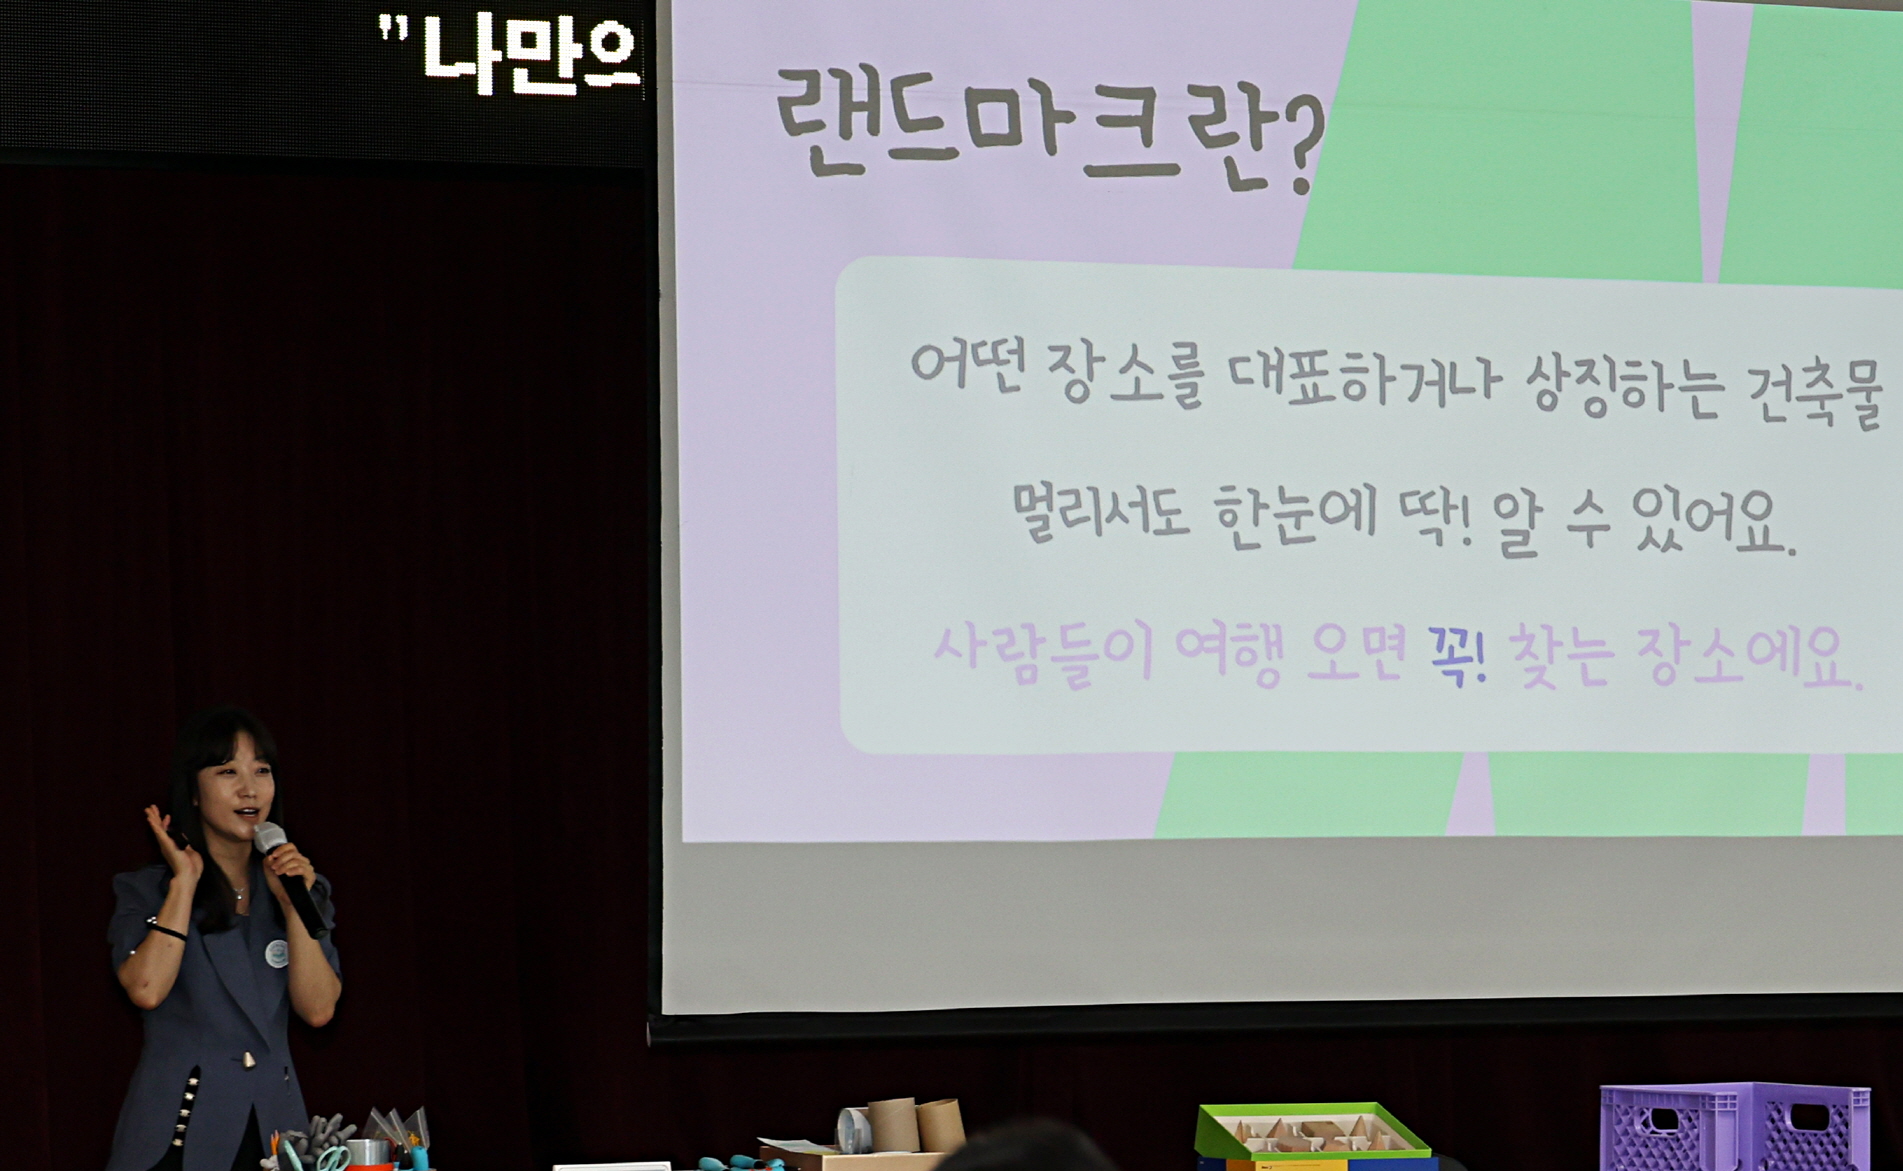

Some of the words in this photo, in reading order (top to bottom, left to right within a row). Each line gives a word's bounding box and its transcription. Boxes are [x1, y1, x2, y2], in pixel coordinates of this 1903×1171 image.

[777, 63, 1325, 196] 랜드마크란?
[910, 334, 1026, 396] 어떤
[1047, 337, 1206, 411] 장소를
[1227, 345, 1504, 409] 대표하거나
[1525, 350, 1726, 421] 상징하는
[1747, 354, 1884, 433] 건축물
[1013, 479, 1191, 545] 멀리서도
[1213, 482, 1377, 552] 한눈에
[1399, 484, 1472, 548] 딱!
[1493, 486, 1545, 560] 알
[1566, 488, 1612, 550] 수
[1632, 483, 1798, 557] 있어요.
[932, 617, 1153, 692] 사람들이
[1175, 617, 1285, 690] 여행
[1306, 622, 1406, 684] 오면
[1427, 625, 1488, 690] 꼭!
[1508, 621, 1616, 691] 찾는
[1637, 621, 1865, 692] 장소에요.
